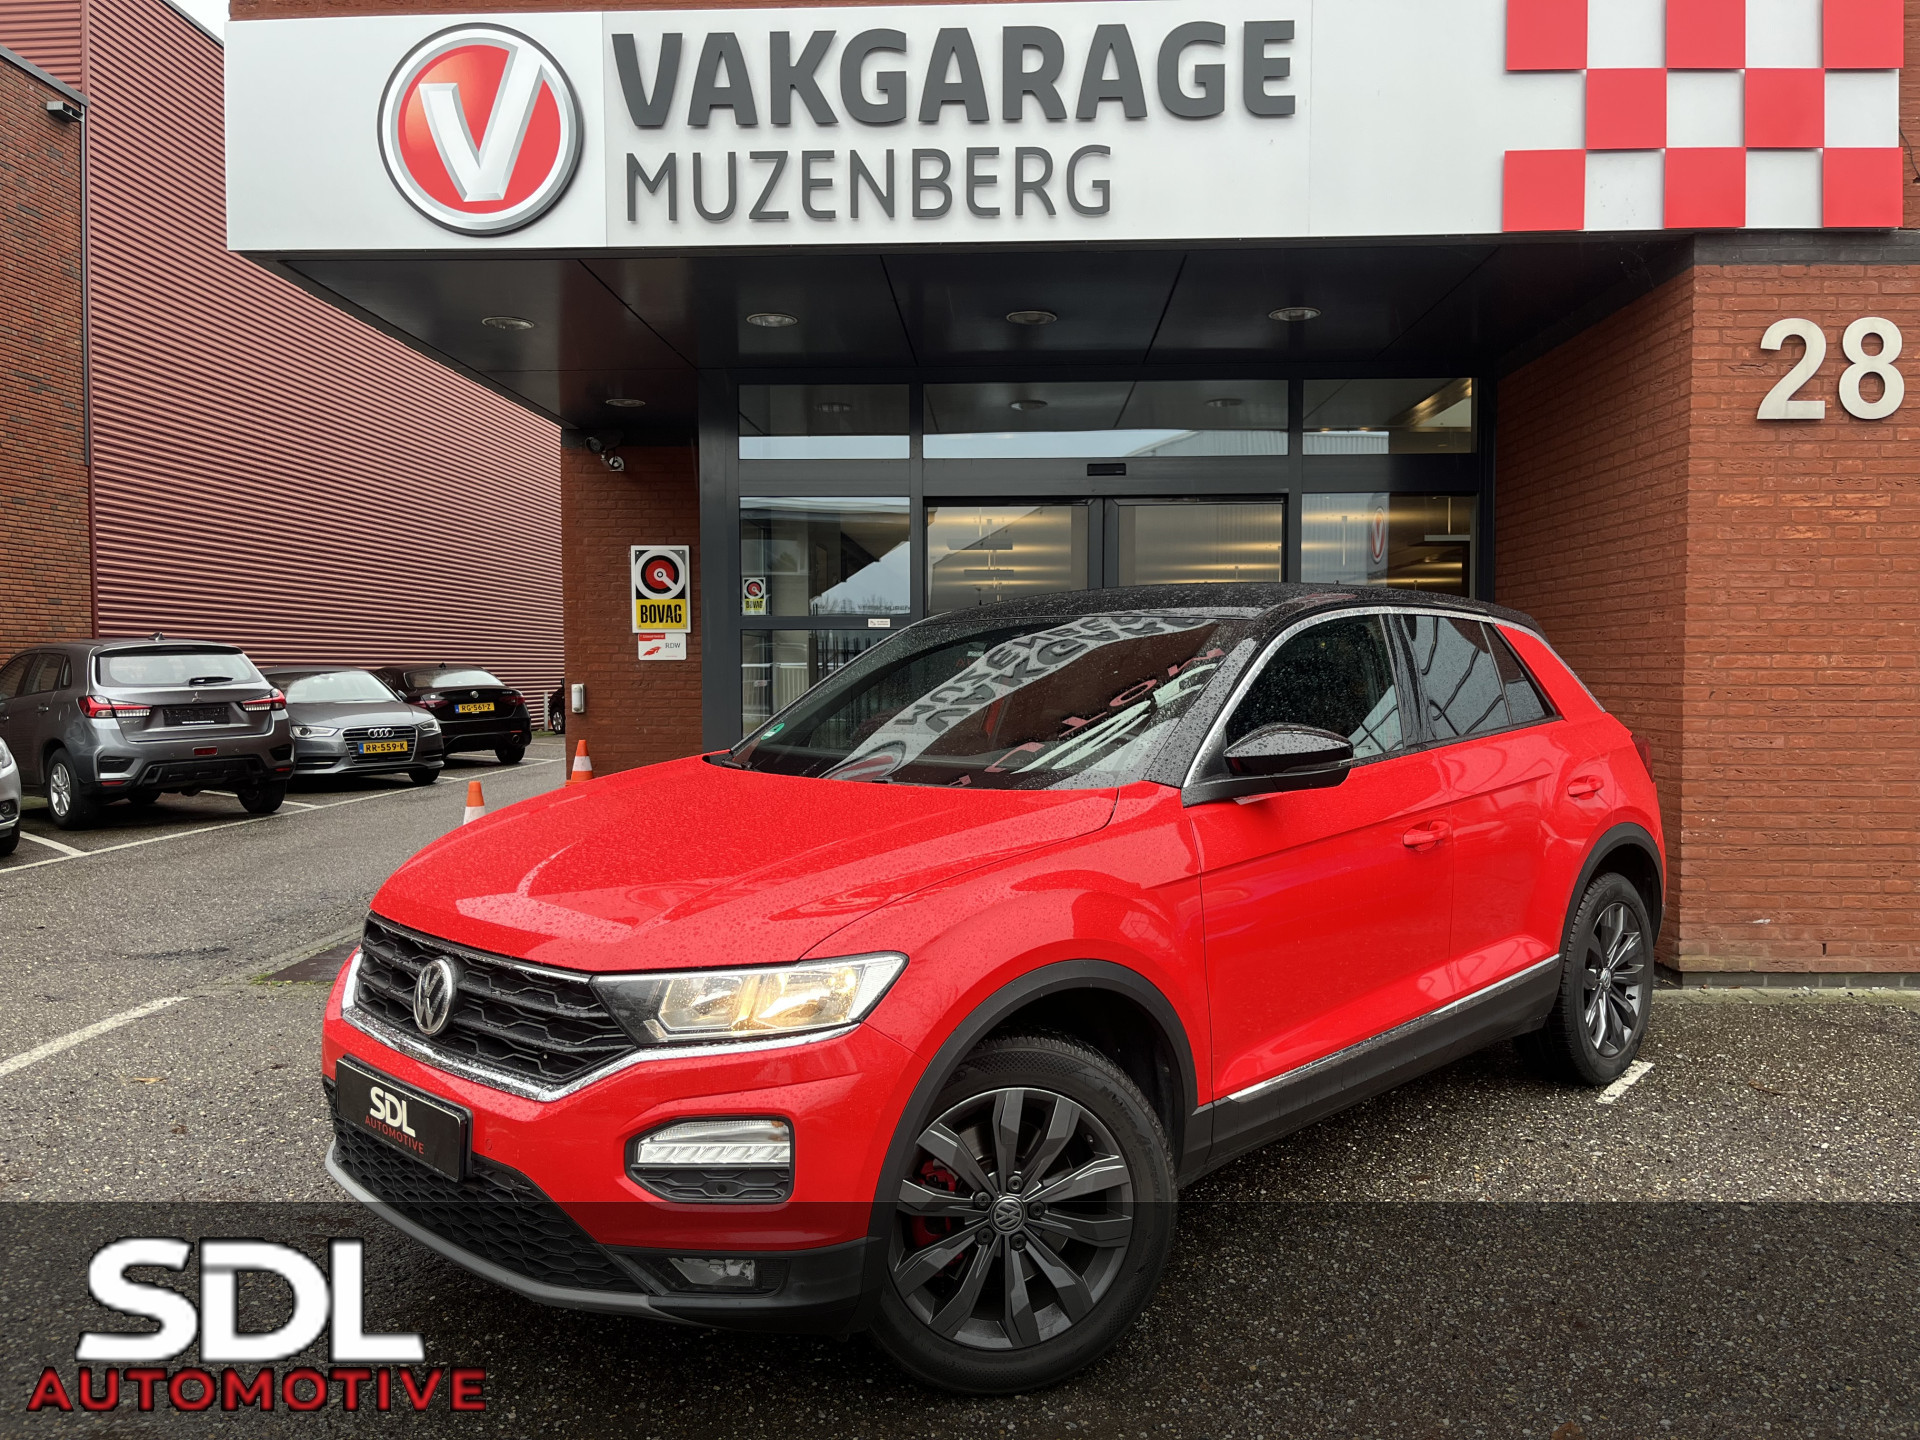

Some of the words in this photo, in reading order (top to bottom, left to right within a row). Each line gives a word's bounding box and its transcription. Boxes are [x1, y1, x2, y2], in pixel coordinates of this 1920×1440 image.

[611, 19, 1296, 128] VAKGARAGE
[626, 144, 1112, 222] MUZENBERG
[1756, 316, 1905, 420] 28
[640, 604, 683, 624] BOVAG
[461, 703, 491, 712] RG-561-Z
[366, 742, 405, 752] RR-559-K
[364, 1114, 425, 1155] AUTOMOTIVE
[369, 1086, 416, 1137] SDL
